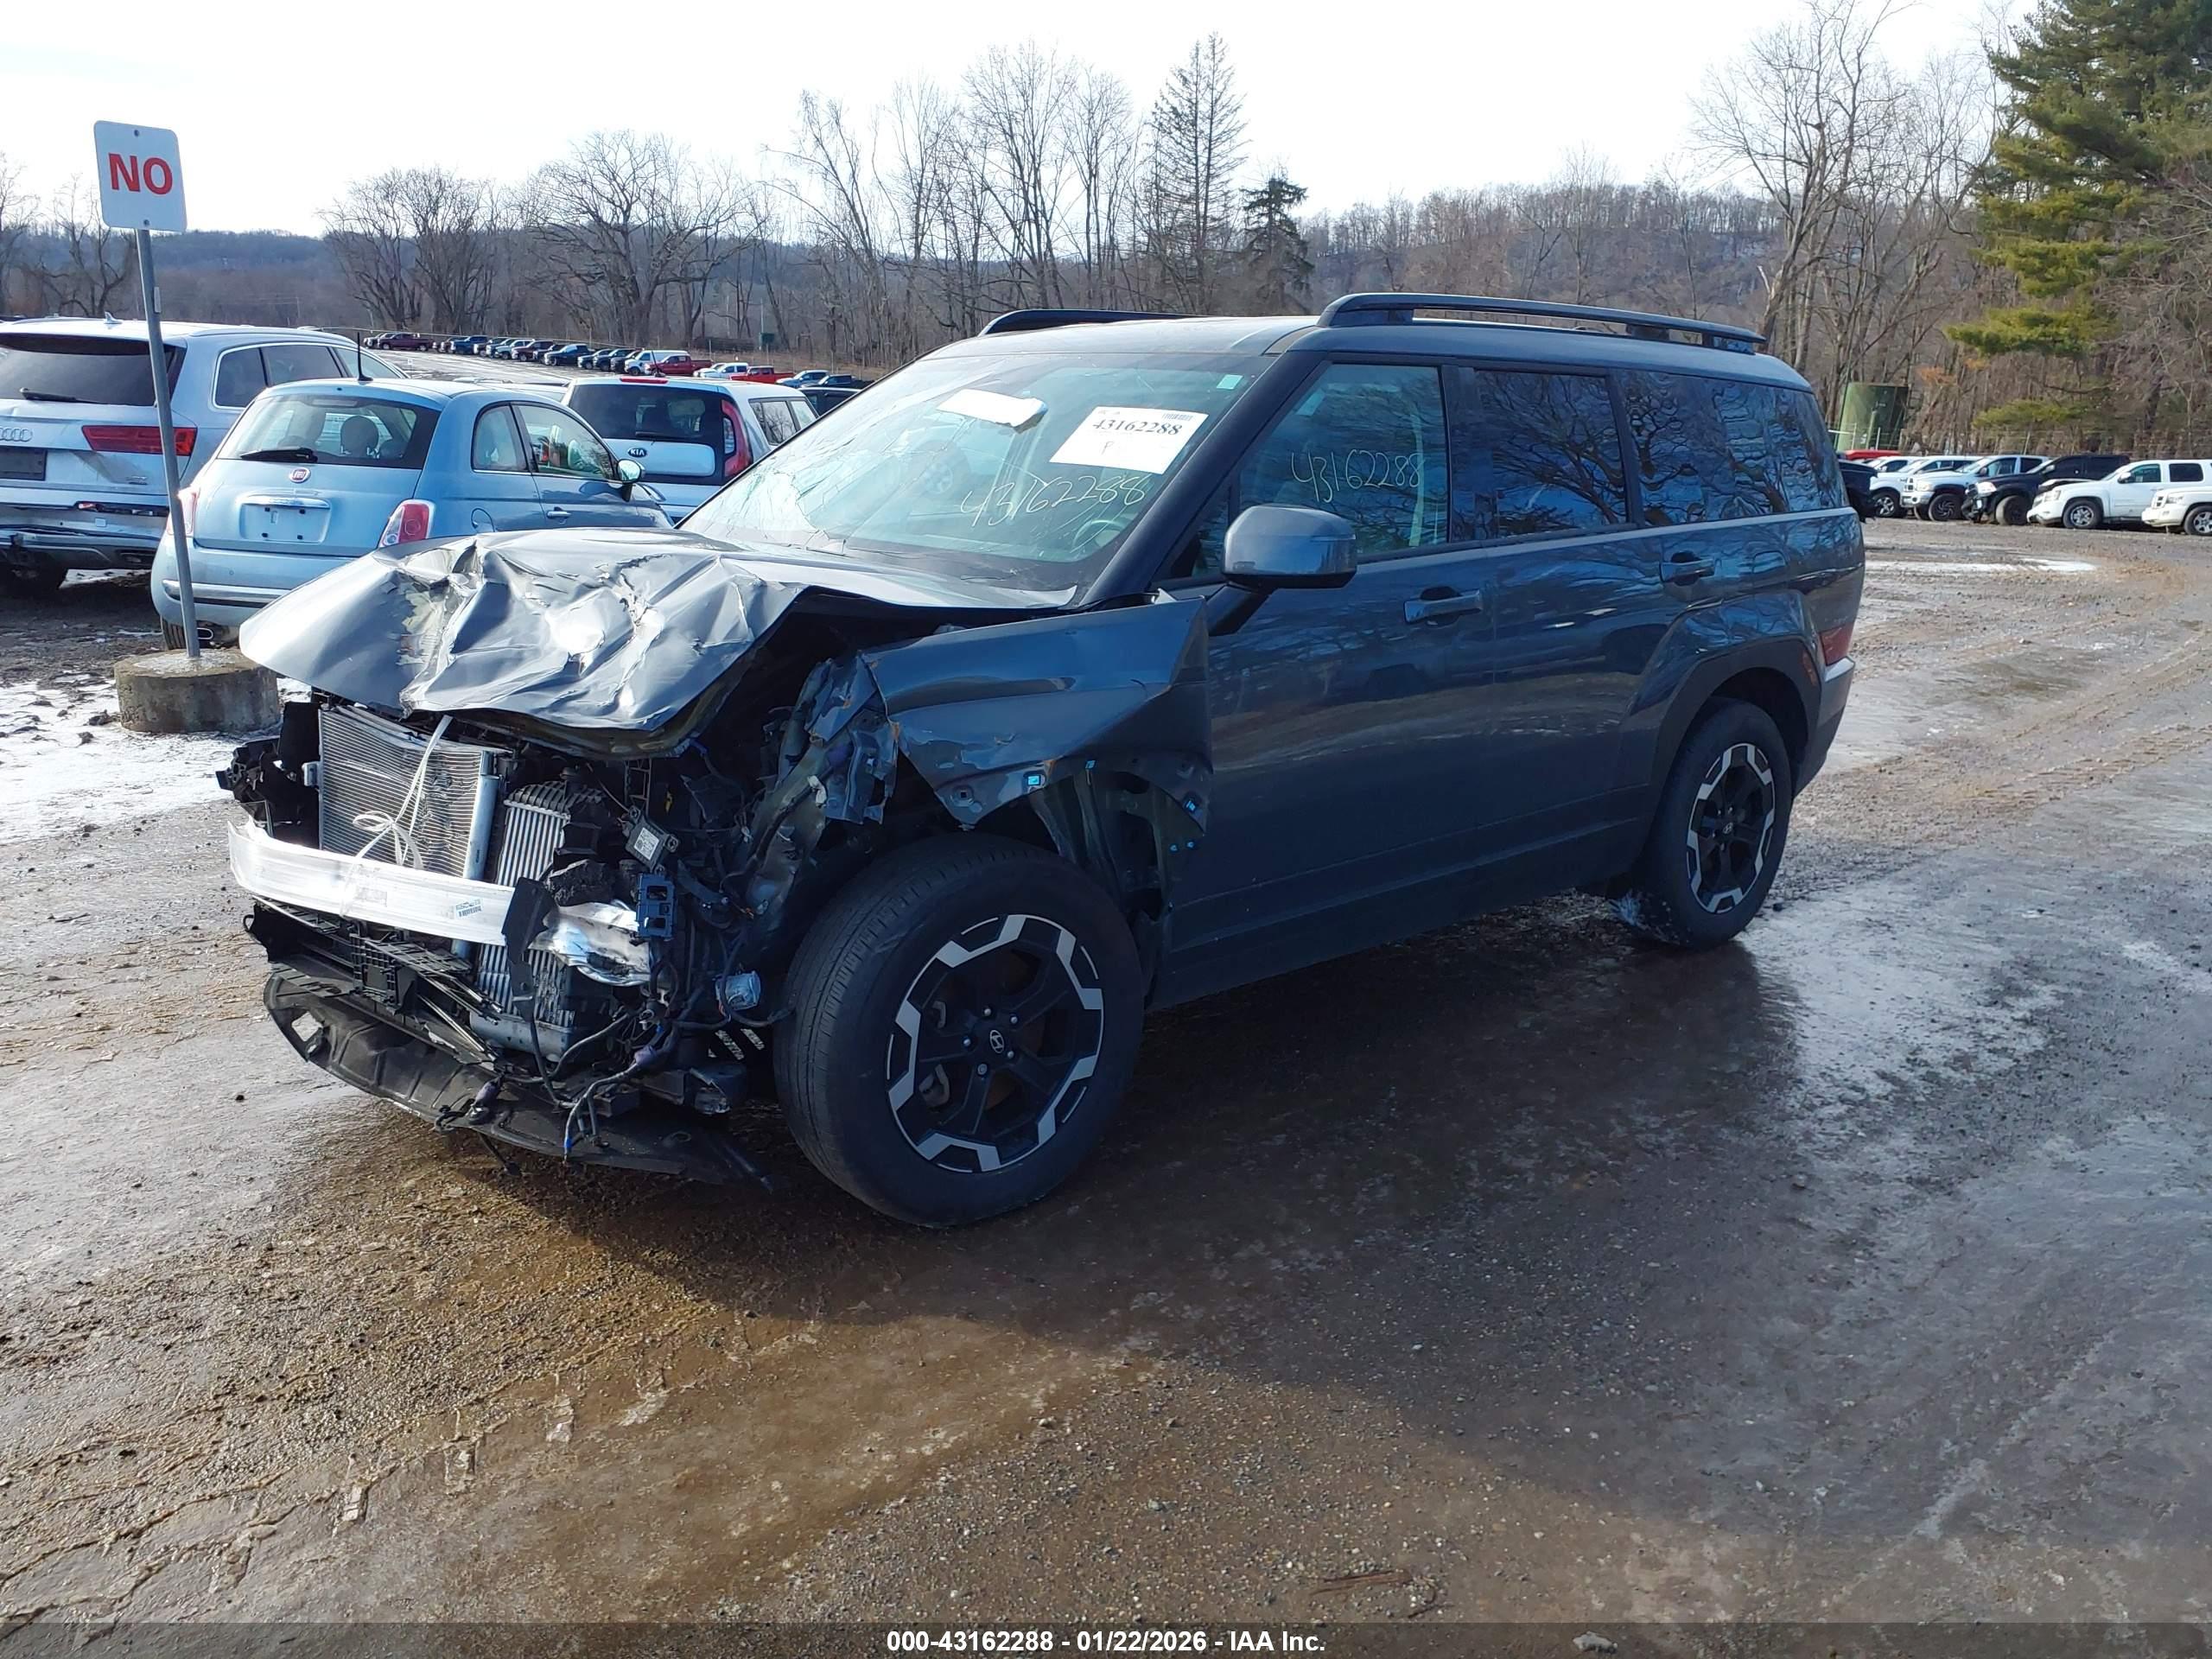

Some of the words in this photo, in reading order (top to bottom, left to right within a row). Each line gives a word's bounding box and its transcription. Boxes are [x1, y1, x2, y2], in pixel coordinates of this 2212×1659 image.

[108, 152, 173, 194] NO
[1092, 418, 1183, 435] 43162288
[1291, 448, 1426, 503] 43162288
[960, 475, 1146, 527] 43162288
